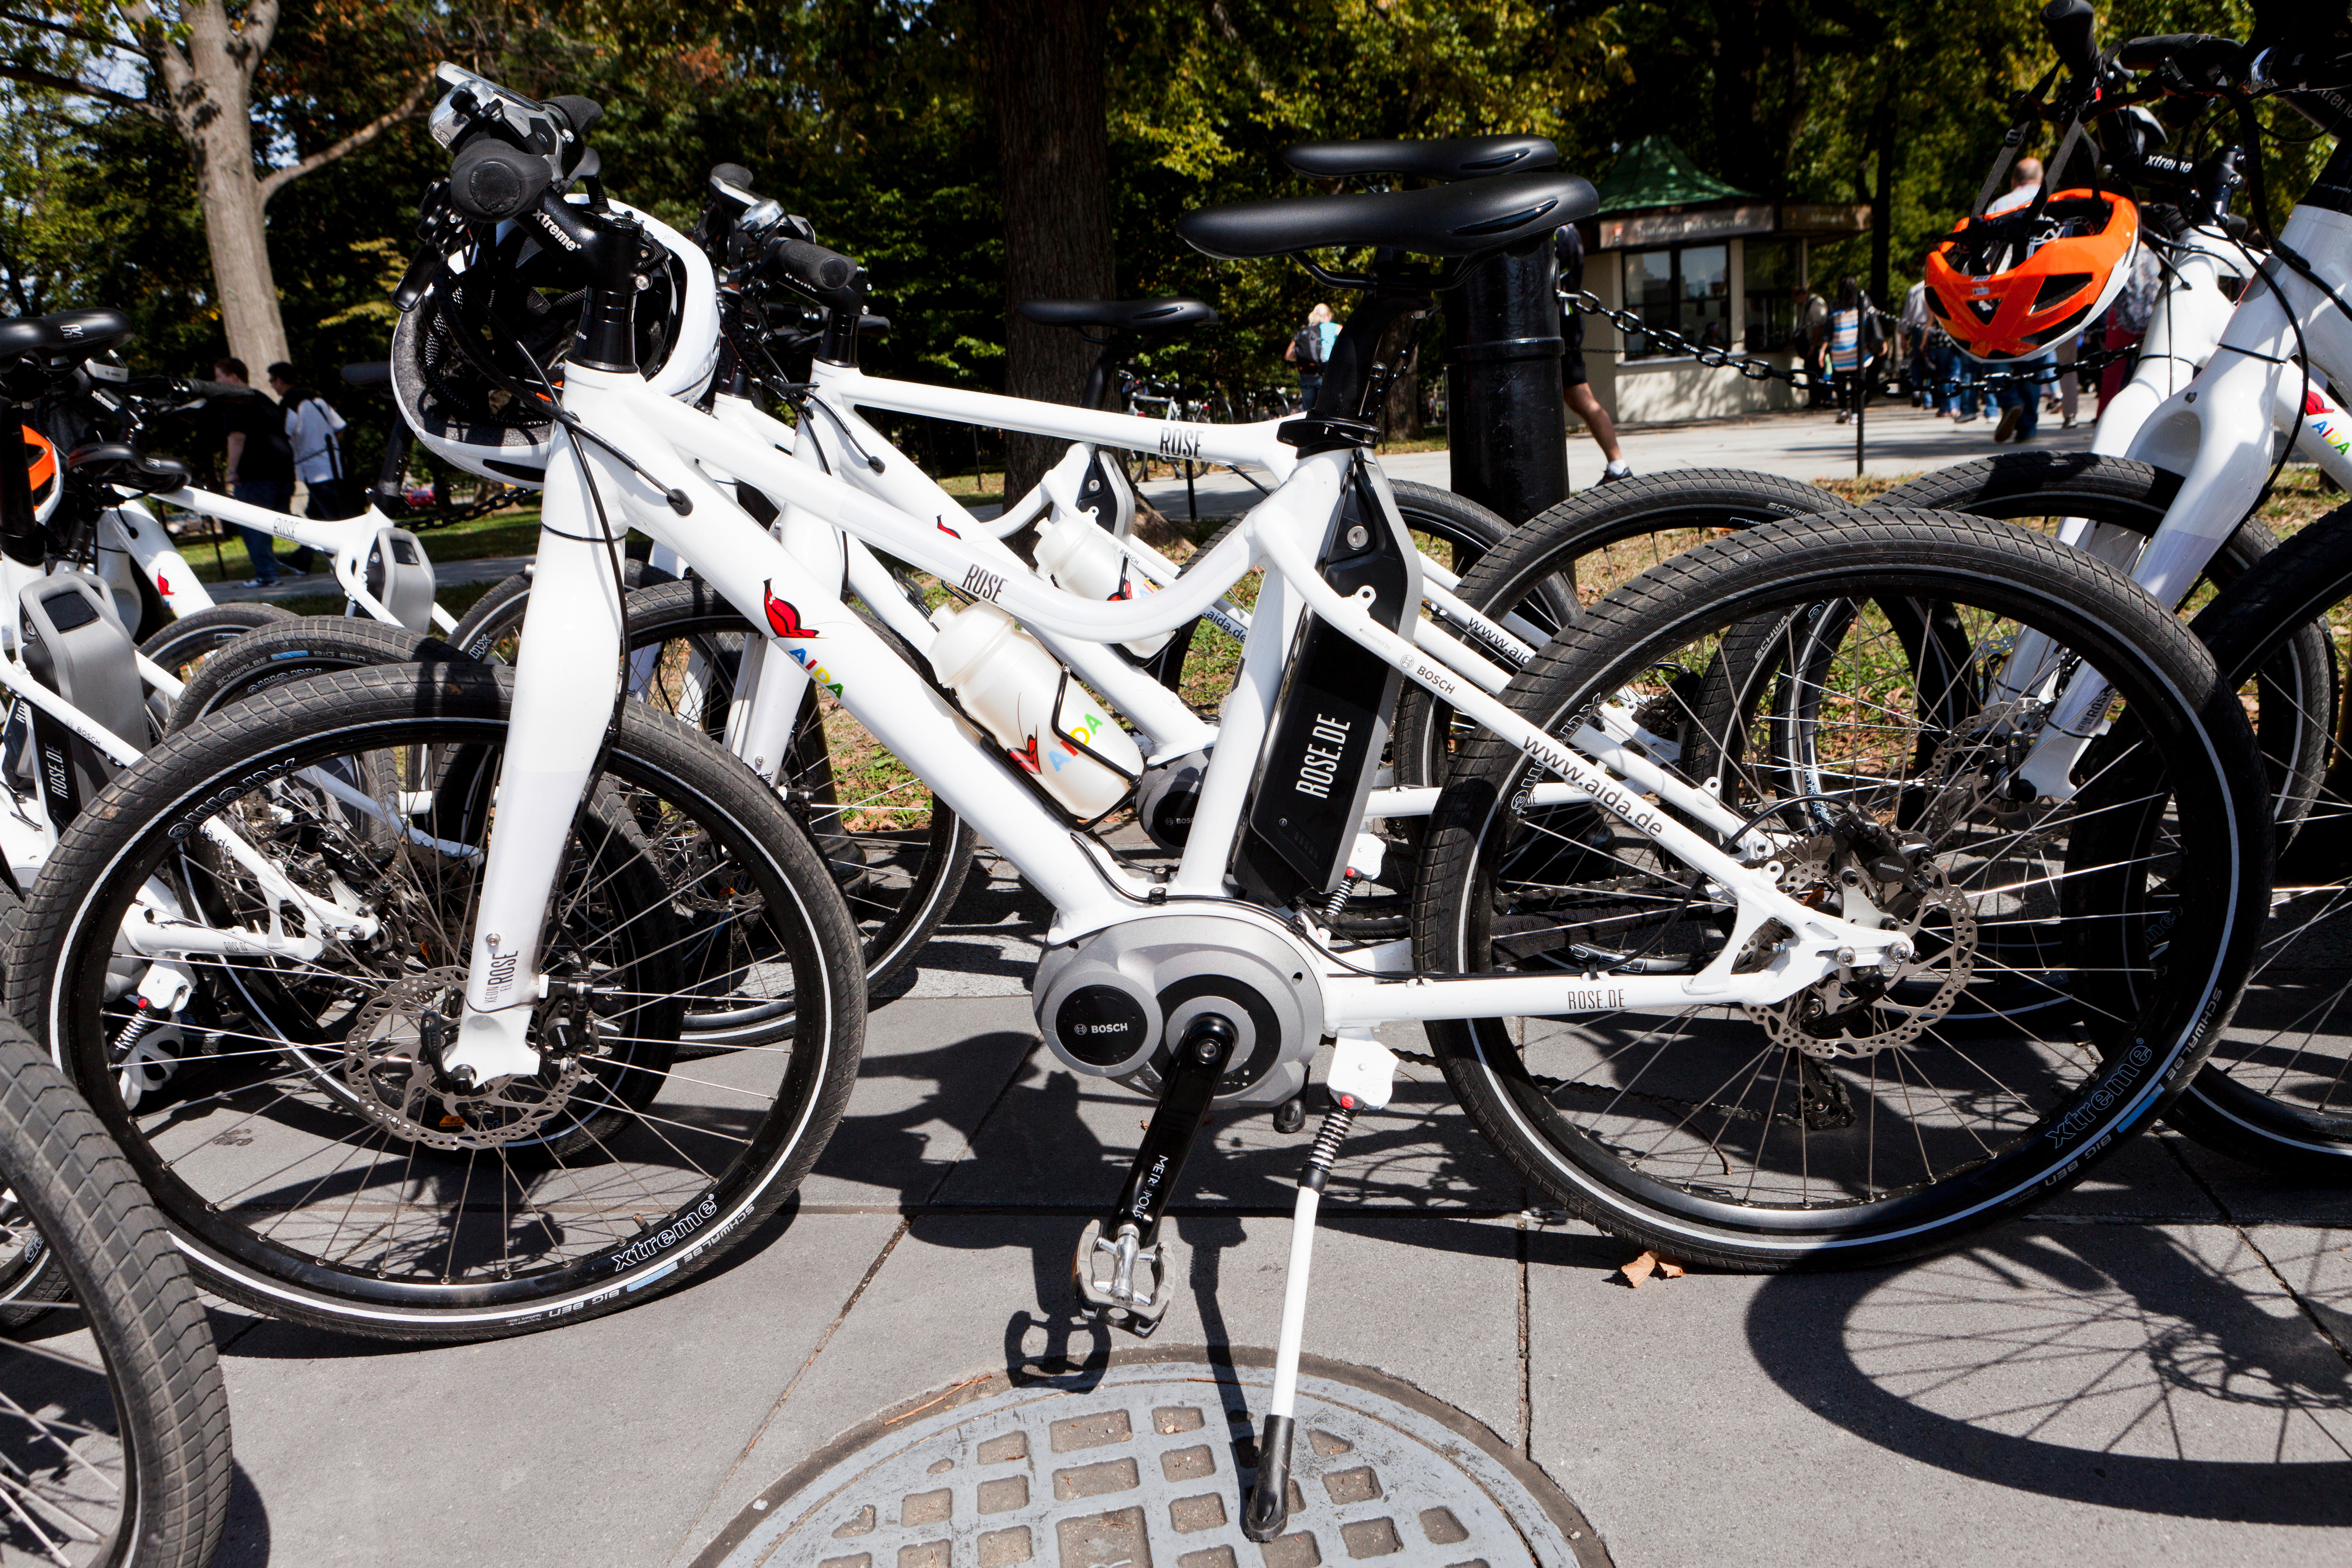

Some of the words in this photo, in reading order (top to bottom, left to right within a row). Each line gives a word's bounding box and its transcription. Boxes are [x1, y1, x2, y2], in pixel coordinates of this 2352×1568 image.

[532, 209, 576, 251] xtreme
[91, 390, 116, 412] xtreme
[1160, 427, 1204, 459] ROSE
[2311, 420, 2350, 456] AIDA
[274, 518, 299, 539] ROSE
[962, 563, 1008, 604] ROSE
[216, 657, 268, 688] SCHWALBE
[788, 647, 843, 700] AIDA
[1416, 665, 1456, 694] BOSCH
[77, 727, 101, 746] BOSCH
[1048, 713, 1104, 772] AIDA
[1511, 692, 1601, 810] xtrme
[44, 743, 69, 798] ROSE.DE
[1295, 714, 1351, 799] ROSE.DE
[168, 758, 301, 838] xtreme
[1523, 736, 1663, 837] www.aida.de
[1879, 863, 1904, 872] SHIMANO
[487, 950, 518, 985] ROSE
[484, 986, 499, 1004] XEON
[500, 982, 512, 992] EL
[1568, 988, 1626, 1009] ROSE.DE
[557, 1026, 567, 1047] SHIMANO
[1091, 1023, 1128, 1034] BOSCH
[2166, 987, 2222, 1081] SCHWALBE
[2045, 1045, 2152, 1149] xtreme
[2084, 1134, 2112, 1161] BIG
[612, 1200, 716, 1272] xtreme
[683, 1203, 755, 1263] SCHWALBE
[549, 1301, 584, 1318] BEN
[591, 1289, 619, 1305] BIG
